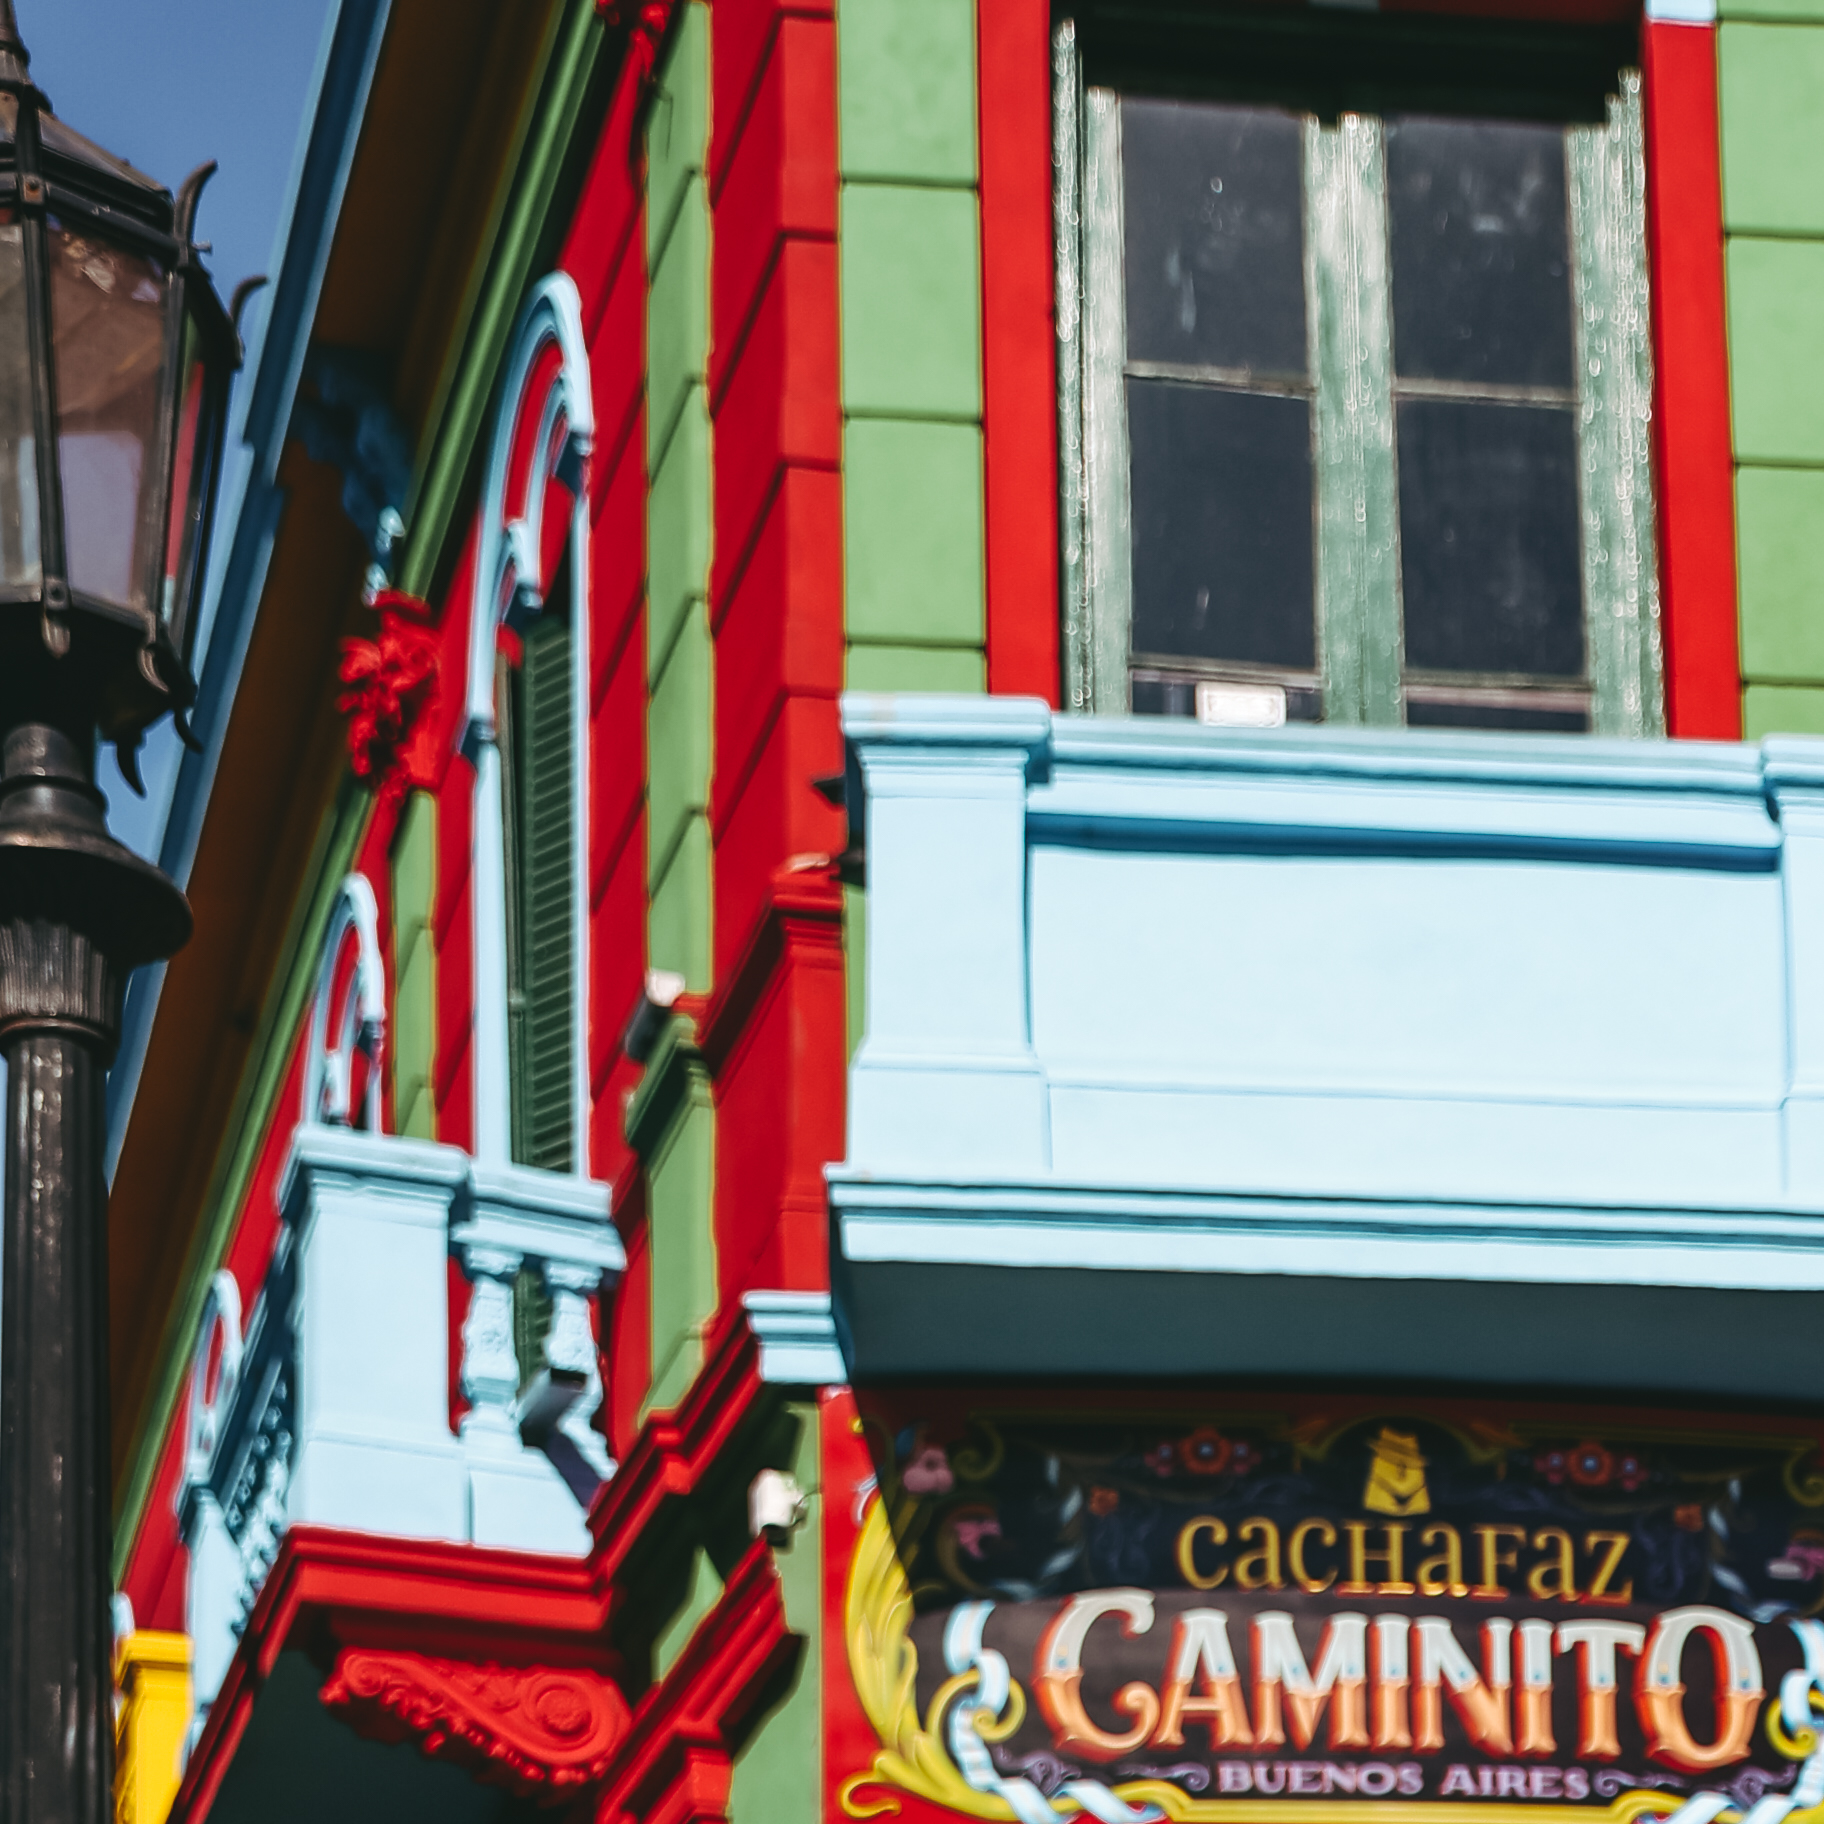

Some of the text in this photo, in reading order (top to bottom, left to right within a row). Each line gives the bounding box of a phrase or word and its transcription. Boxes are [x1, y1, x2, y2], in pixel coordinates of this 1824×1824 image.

[1033, 1587, 1766, 1773] CAMINITO
[1218, 1760, 1590, 1800] BUENOS AIRES
